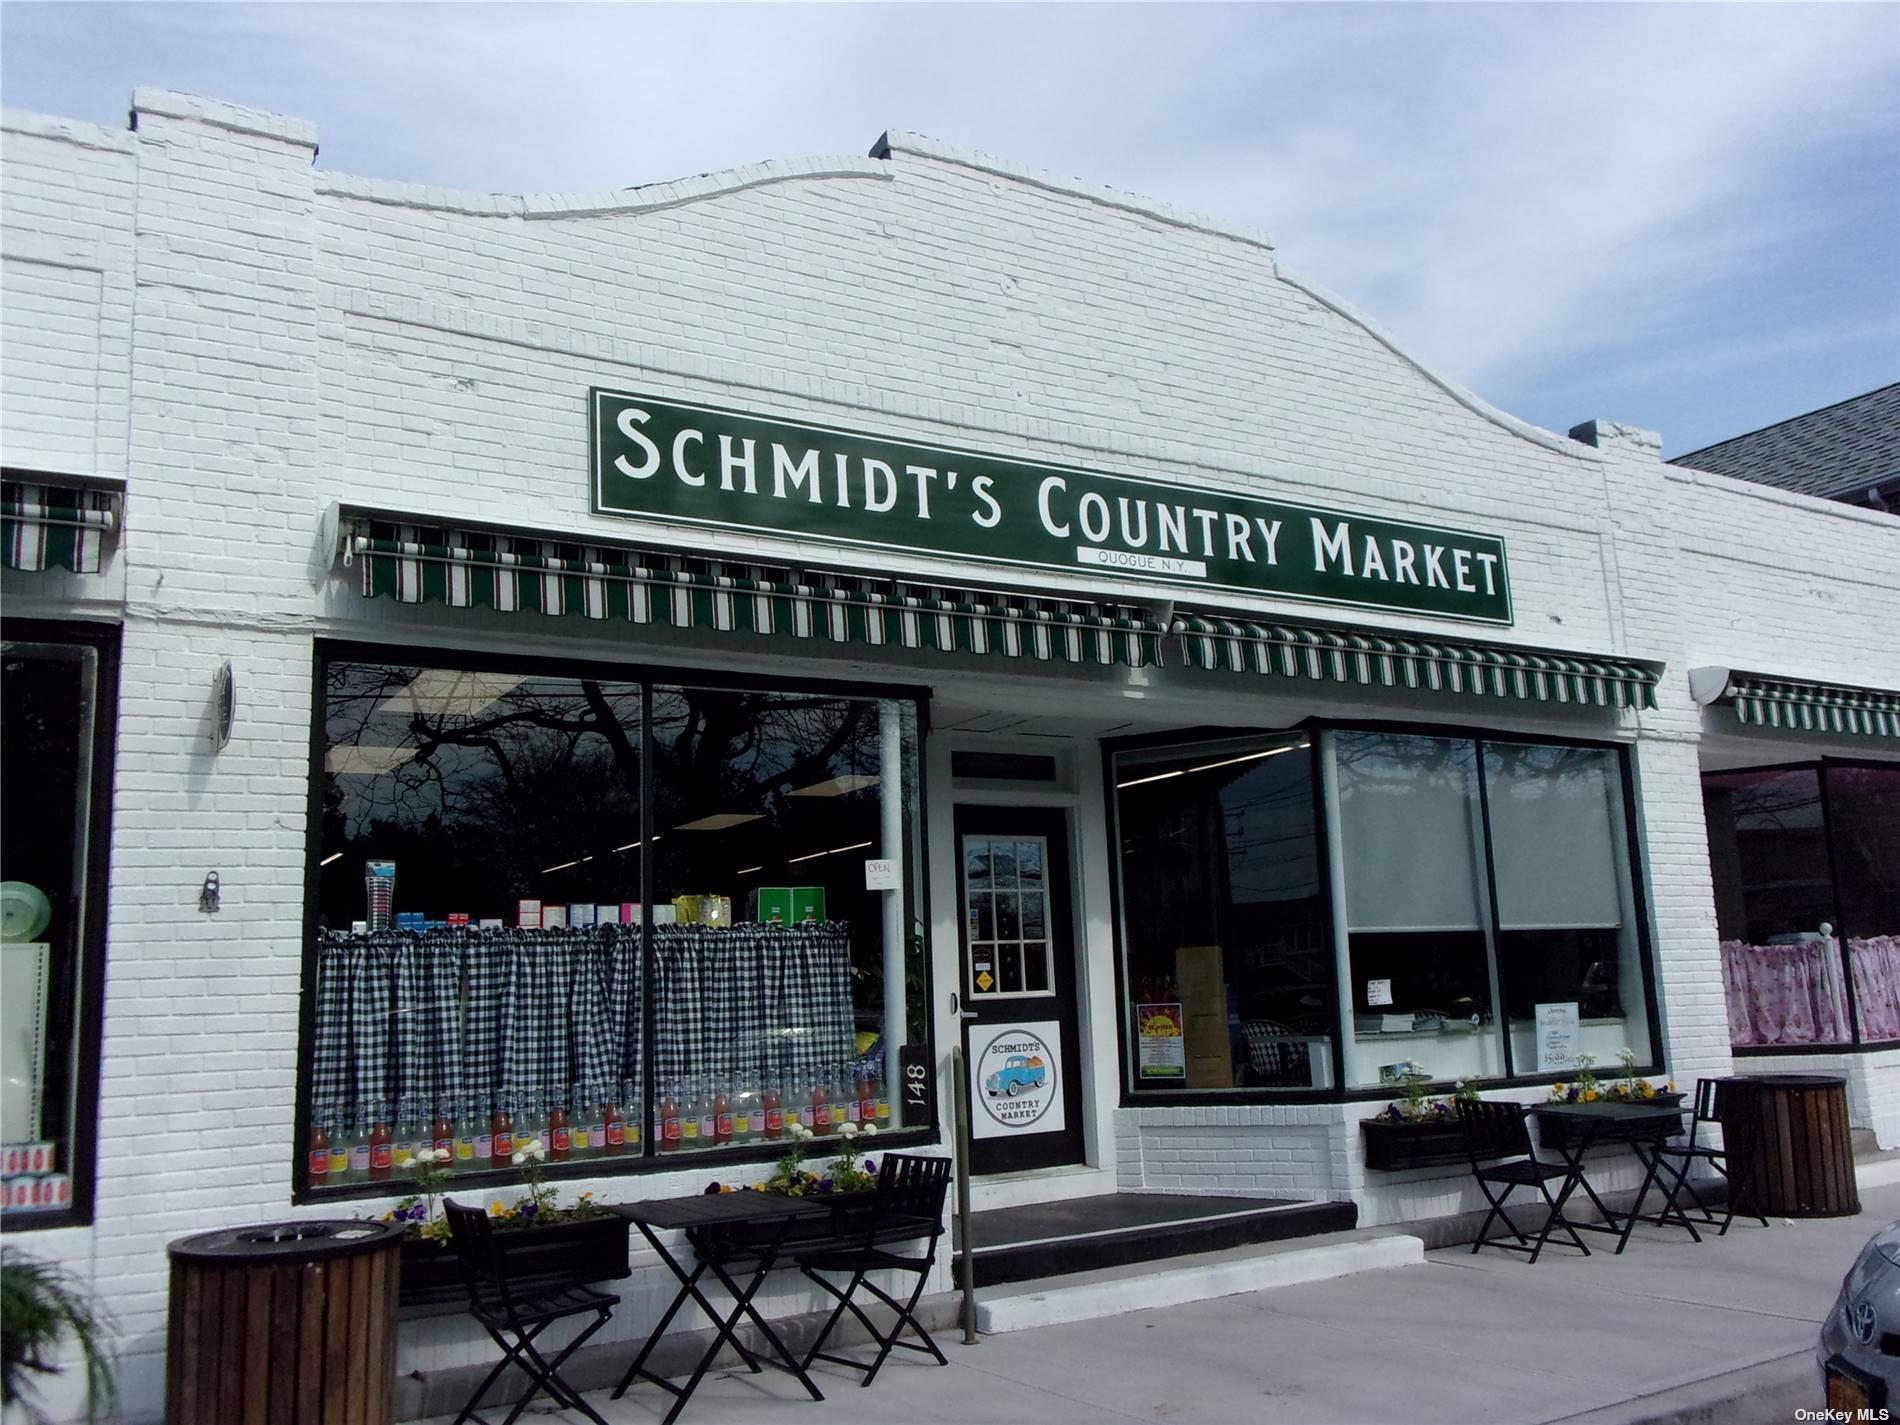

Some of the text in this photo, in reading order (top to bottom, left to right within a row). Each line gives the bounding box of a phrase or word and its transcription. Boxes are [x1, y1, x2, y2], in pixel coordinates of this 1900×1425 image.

[614, 408, 1498, 596] SCHMIDT'S COUNTRY MARKET
[1098, 551, 1155, 569] QUOGUE
[868, 862, 890, 873] OPEN
[907, 1064, 926, 1105] 148
[996, 1100, 1040, 1111] COUNTRY
[1001, 1110, 1037, 1120] MARKET
